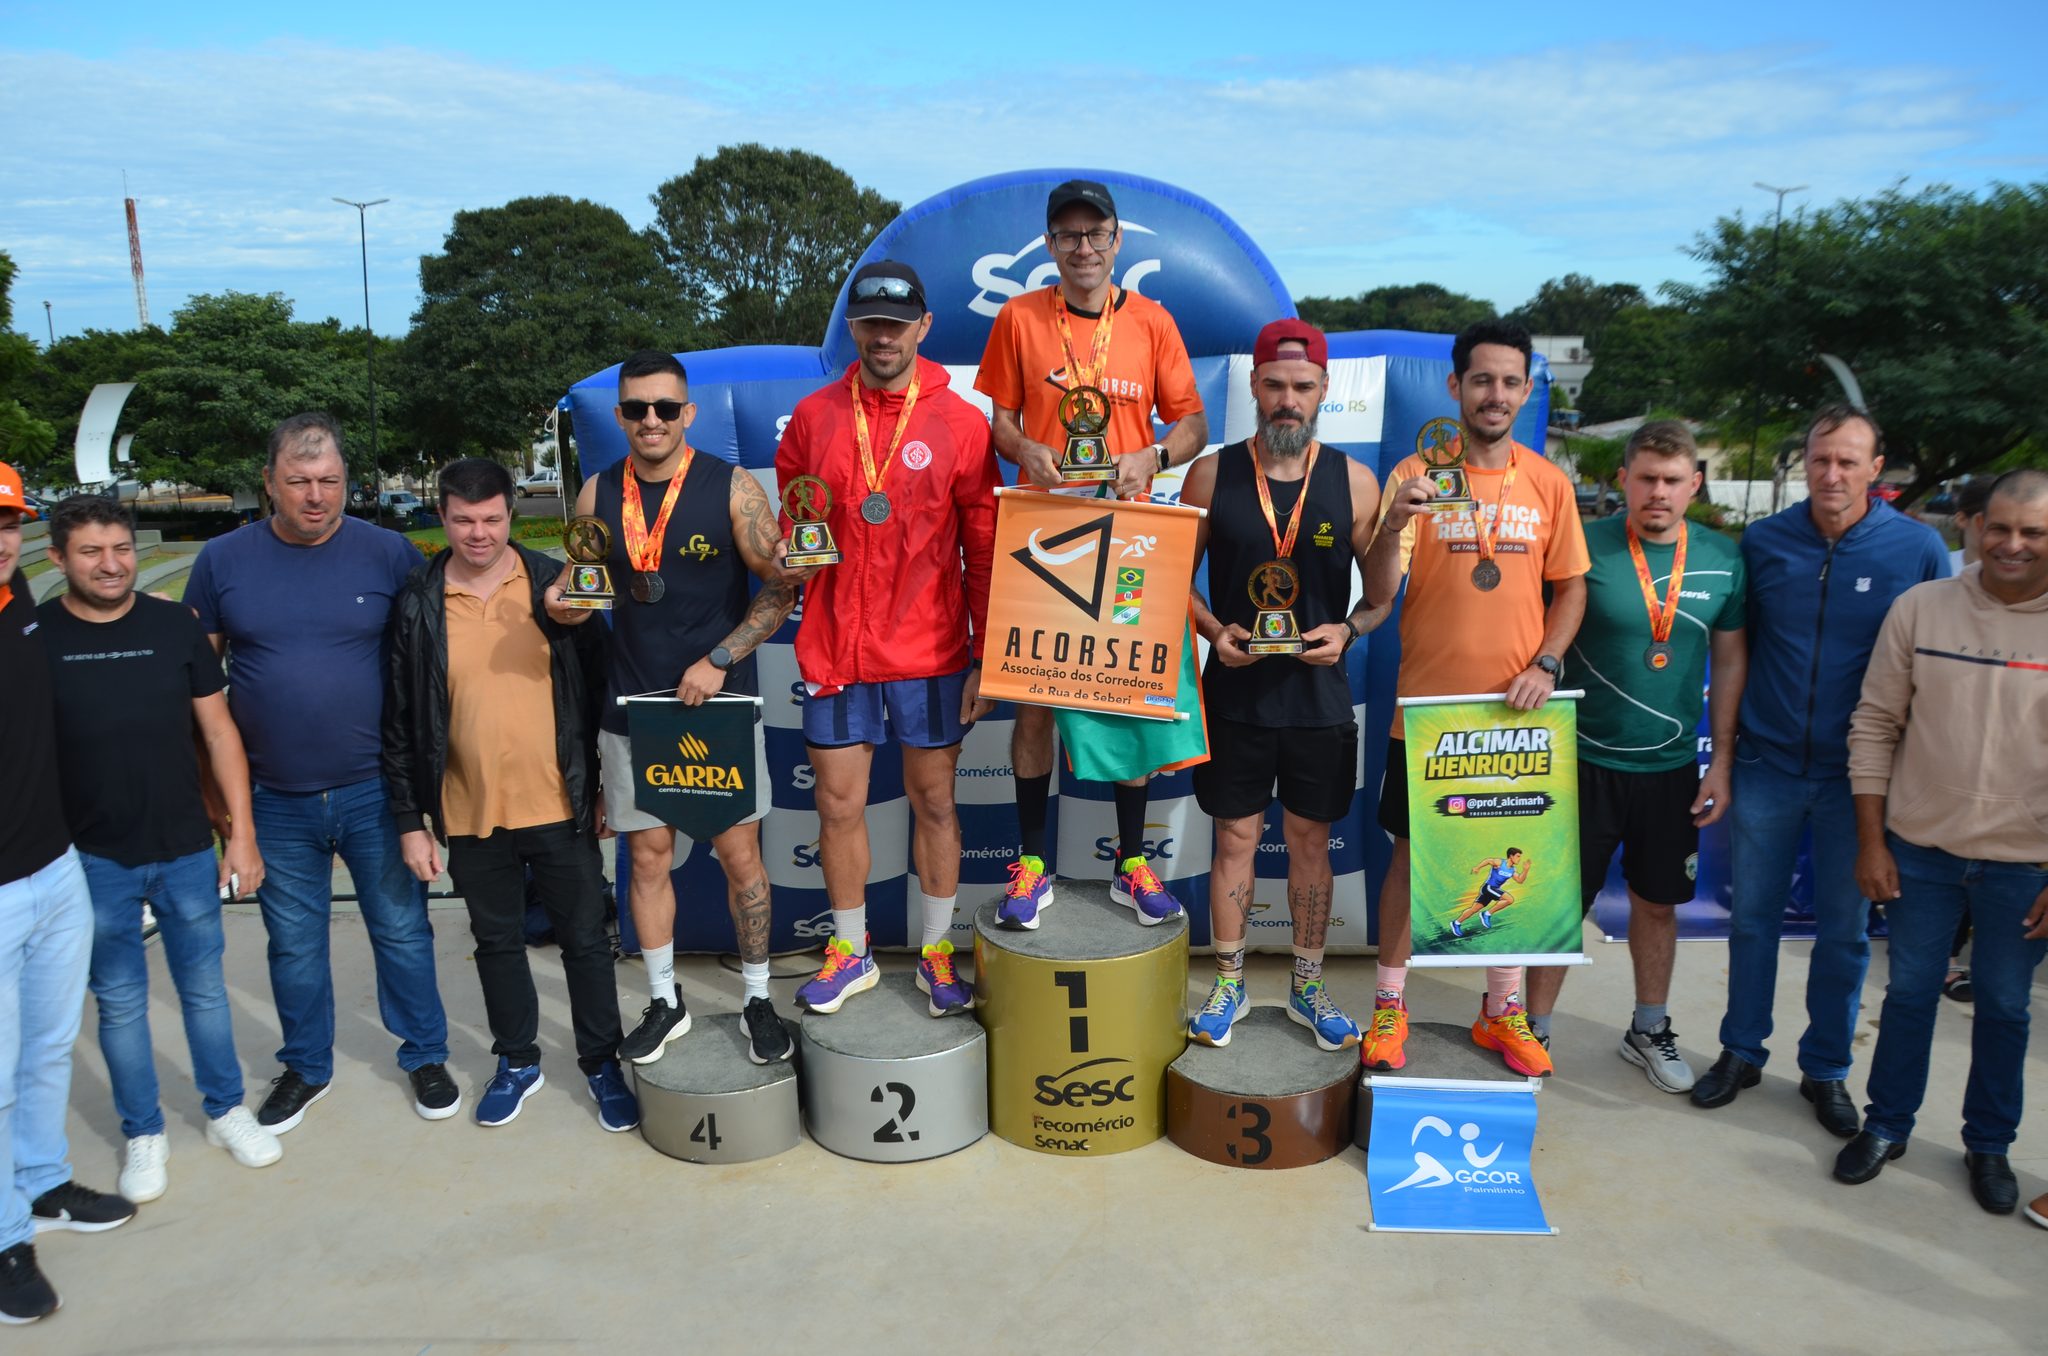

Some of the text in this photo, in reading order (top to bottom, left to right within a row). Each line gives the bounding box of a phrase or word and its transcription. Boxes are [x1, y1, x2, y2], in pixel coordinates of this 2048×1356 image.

[1102, 378, 1143, 398] ORSEB
[1348, 400, 1367, 413] RS
[1004, 626, 1168, 675] ACORSEB
[1000, 661, 1164, 691] Associação dos Corredores
[1028, 684, 1132, 705] de Rua de Seberi
[1437, 728, 1549, 756] ALCIMAR
[954, 765, 1014, 778] comércio
[1428, 751, 1549, 778] HENRIQUE
[645, 764, 745, 790] GARRA
[691, 788, 733, 797] treinamento
[1466, 796, 1544, 810] @prof_alcimarh
[960, 847, 1014, 859] omércio
[1095, 837, 1174, 861] Ssc
[1328, 837, 1345, 850] RS
[1054, 971, 1089, 1053] 1
[1034, 1074, 1134, 1107] Sesc
[870, 1082, 920, 1143] 2
[690, 1113, 722, 1150] 4
[1033, 1115, 1135, 1133] Fecomércio
[1226, 1102, 1273, 1165] 3
[1035, 1134, 1089, 1150] Senac
[1455, 1169, 1521, 1184] GCOR
[1464, 1186, 1526, 1195] Palmitinho
